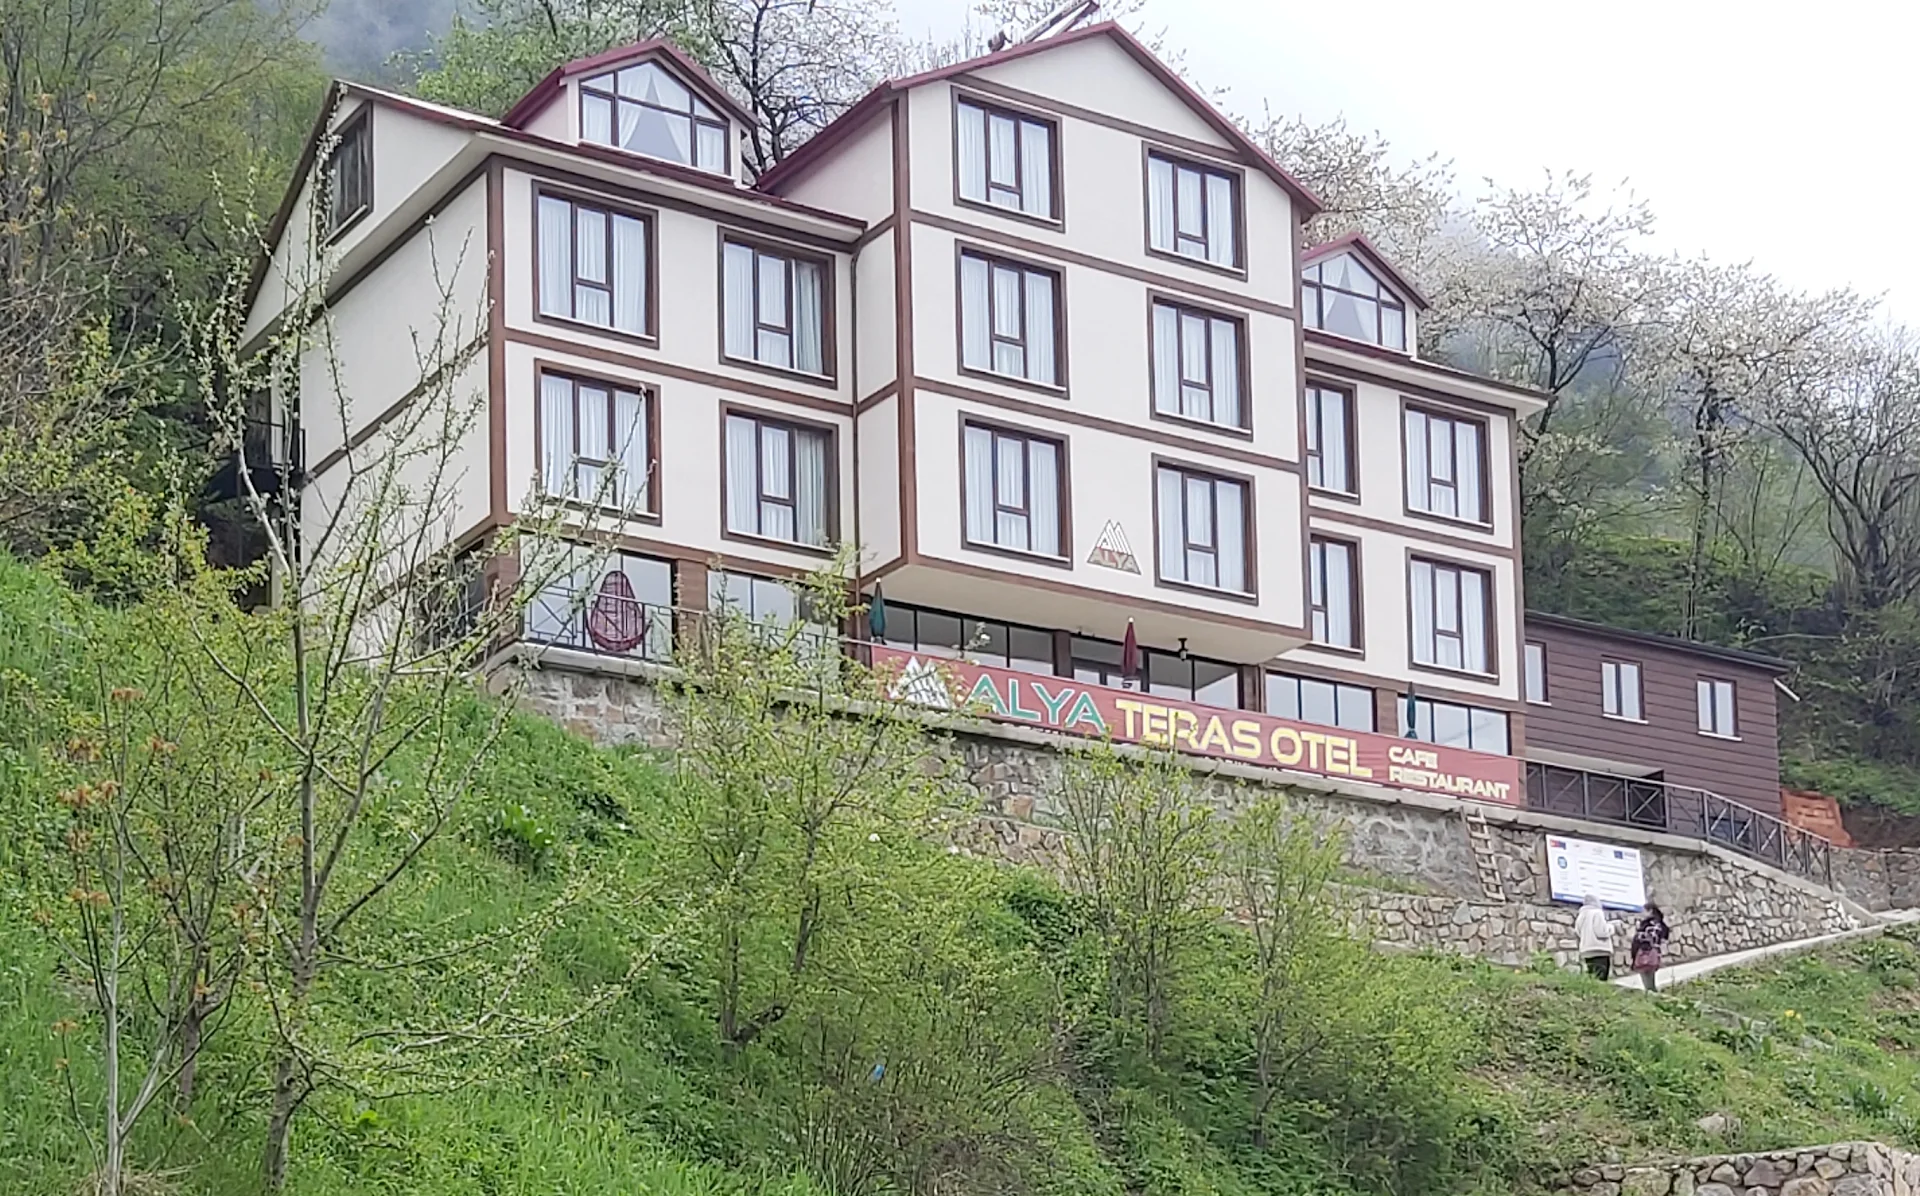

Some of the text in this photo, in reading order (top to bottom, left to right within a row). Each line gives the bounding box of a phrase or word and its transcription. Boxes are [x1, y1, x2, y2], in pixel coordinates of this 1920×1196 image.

[964, 673, 1373, 778] ALYA TERAS OTEL
[1388, 746, 1438, 769] CAFE
[1388, 769, 1511, 800] RESTAURANT
